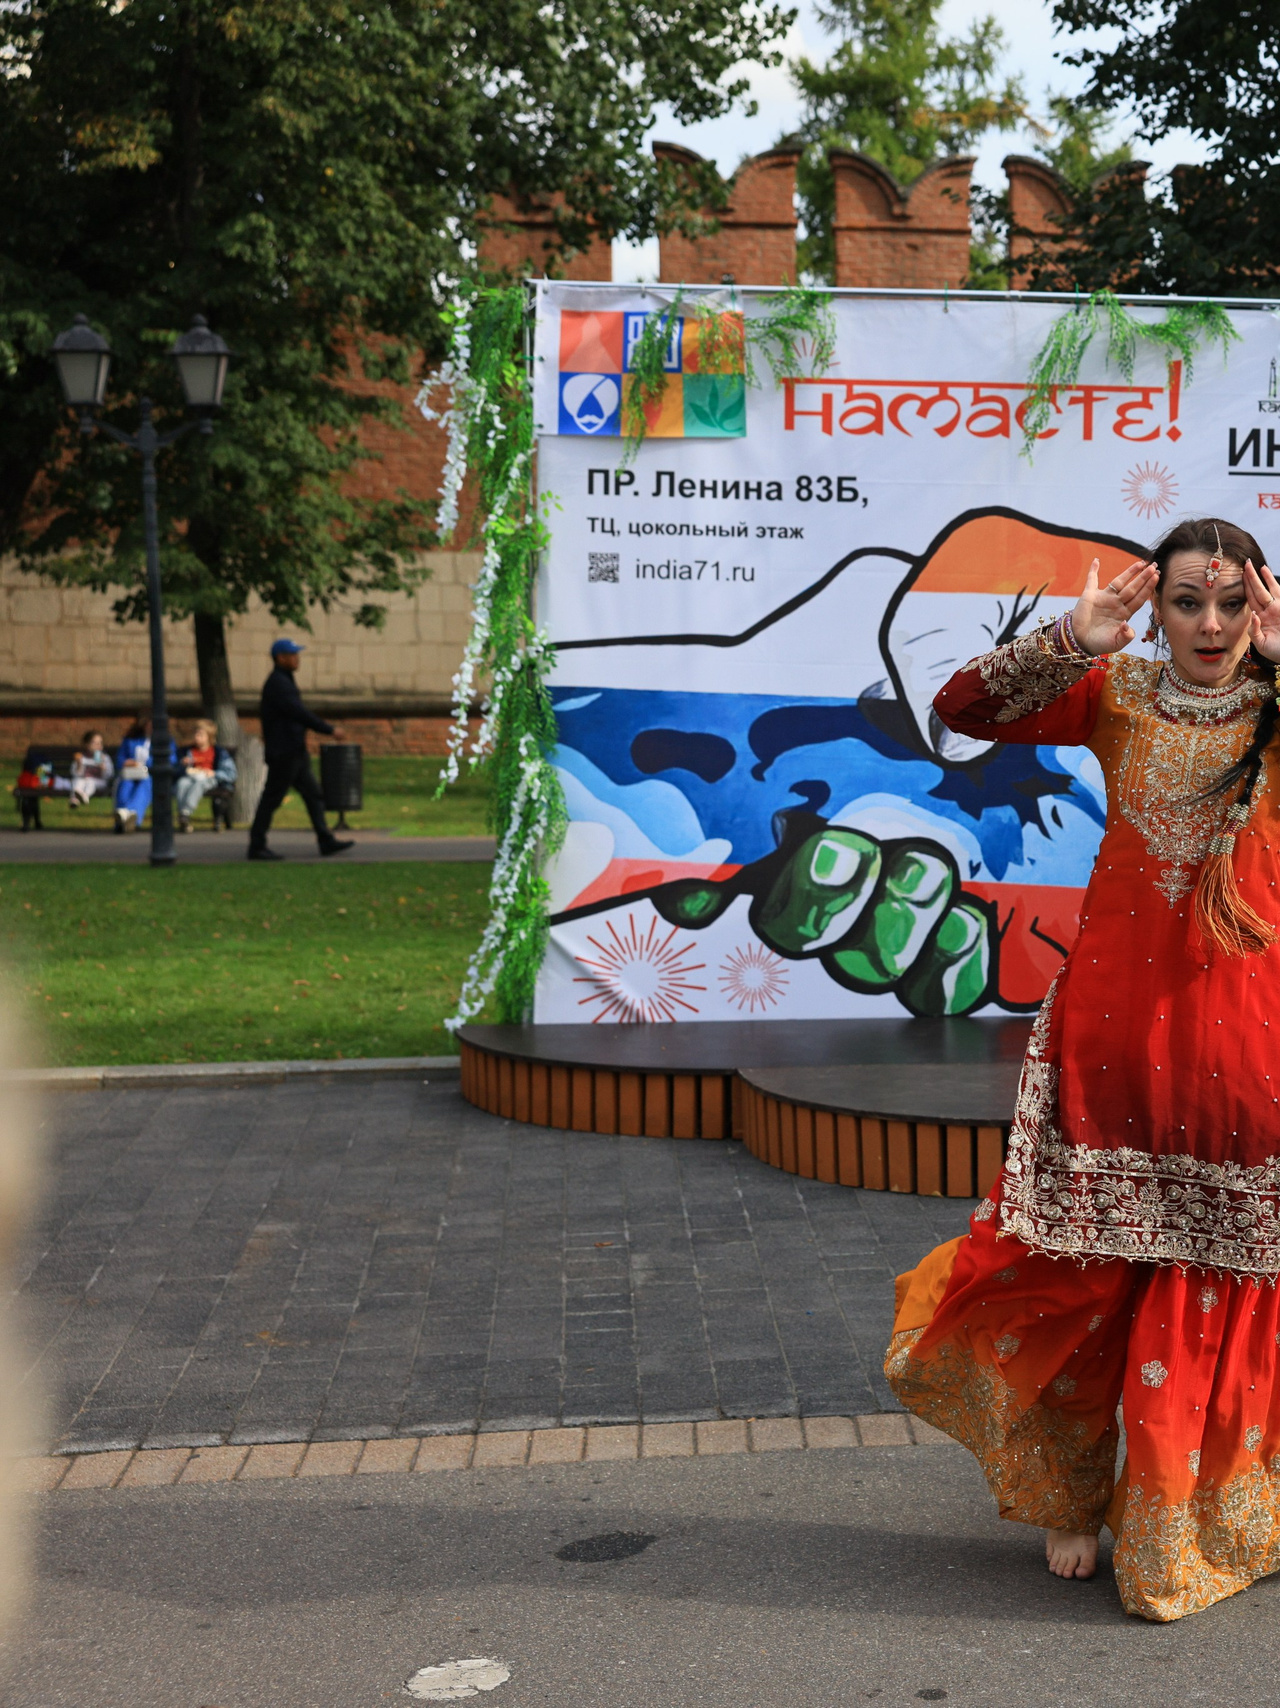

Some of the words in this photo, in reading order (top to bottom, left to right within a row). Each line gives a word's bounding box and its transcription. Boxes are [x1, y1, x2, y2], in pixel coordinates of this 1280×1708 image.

[587, 469, 640, 497] ПР.
[651, 471, 783, 501] Ленина
[795, 475, 869, 508] 83Б,
[587, 517, 621, 538] ТЦ,
[628, 522, 749, 538] цокольный
[755, 527, 804, 539] этаж
[636, 558, 755, 582] india71.ru
